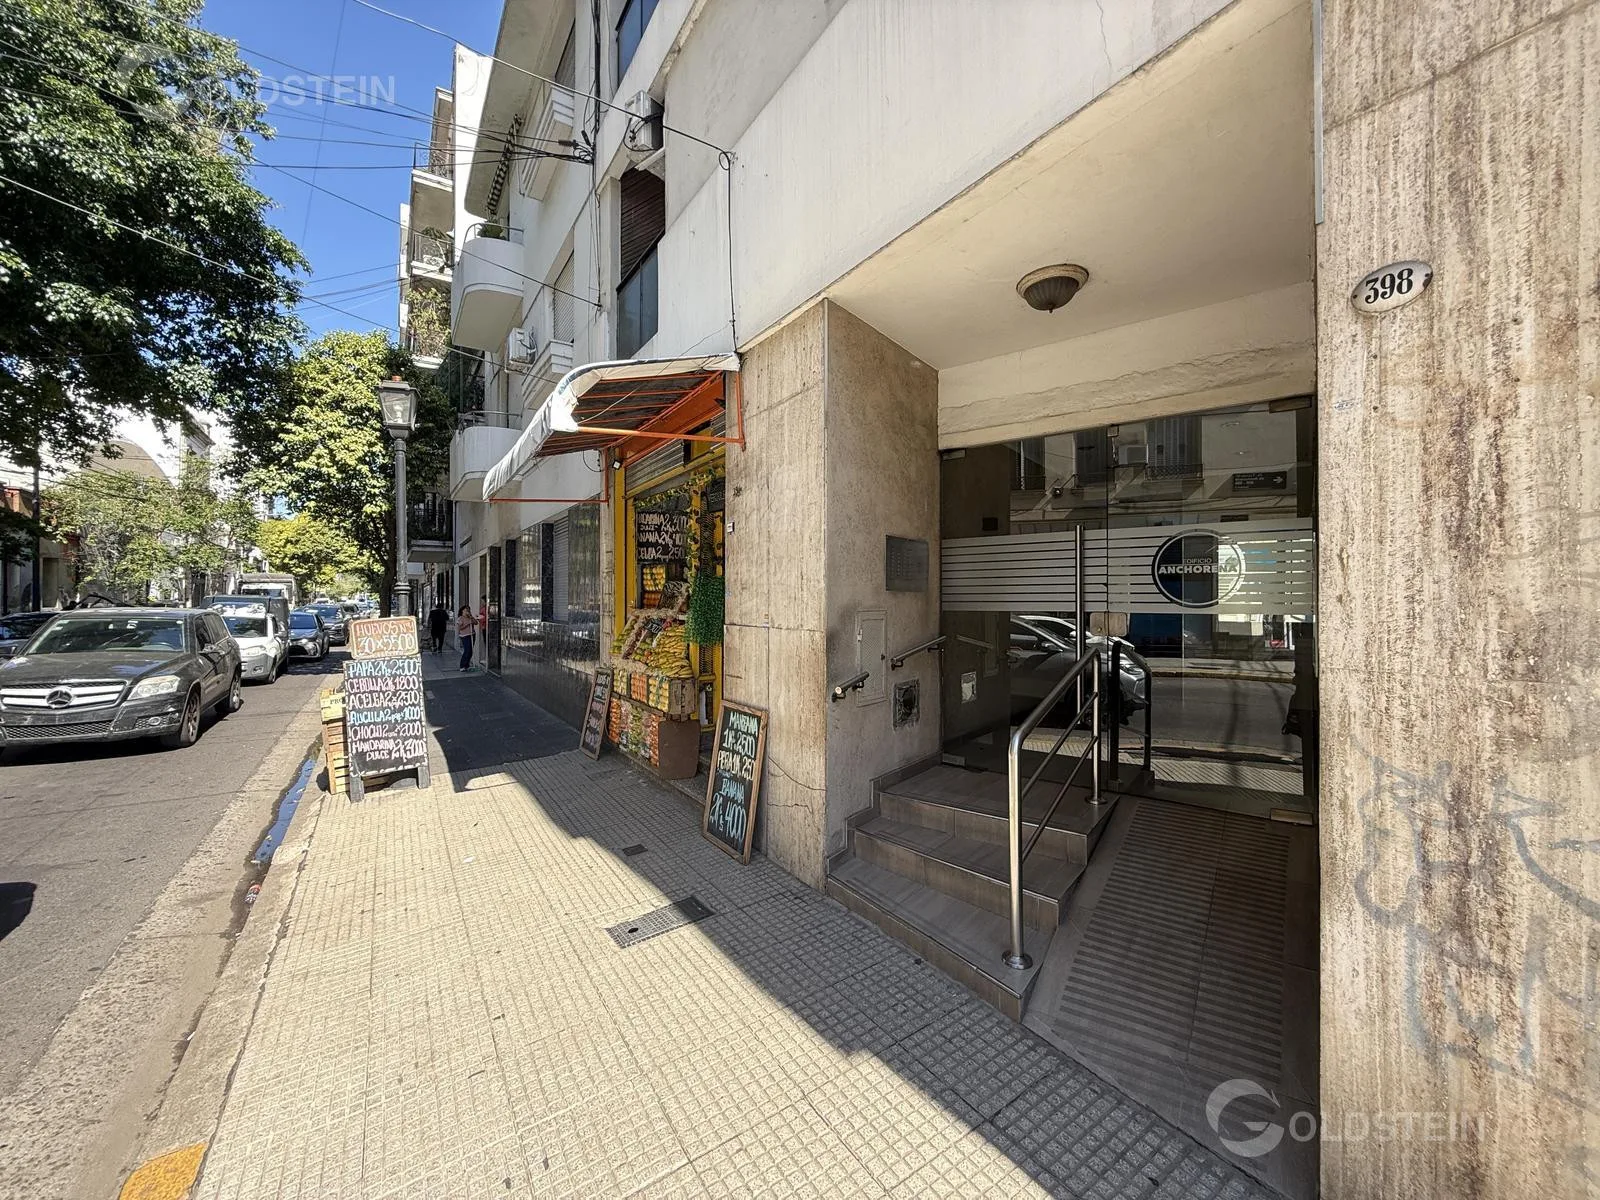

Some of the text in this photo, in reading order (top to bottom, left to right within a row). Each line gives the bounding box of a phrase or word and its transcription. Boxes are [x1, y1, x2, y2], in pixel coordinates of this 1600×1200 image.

[1364, 267, 1414, 304] 398
[1158, 564, 1239, 574] ANCHORENA
[356, 621, 398, 637] HUEVOS
[348, 661, 375, 677] PAPA
[390, 659, 418, 675] 2500
[348, 677, 384, 693] CEBOLLA
[395, 675, 419, 690] 1800
[349, 692, 386, 710] ACELGA
